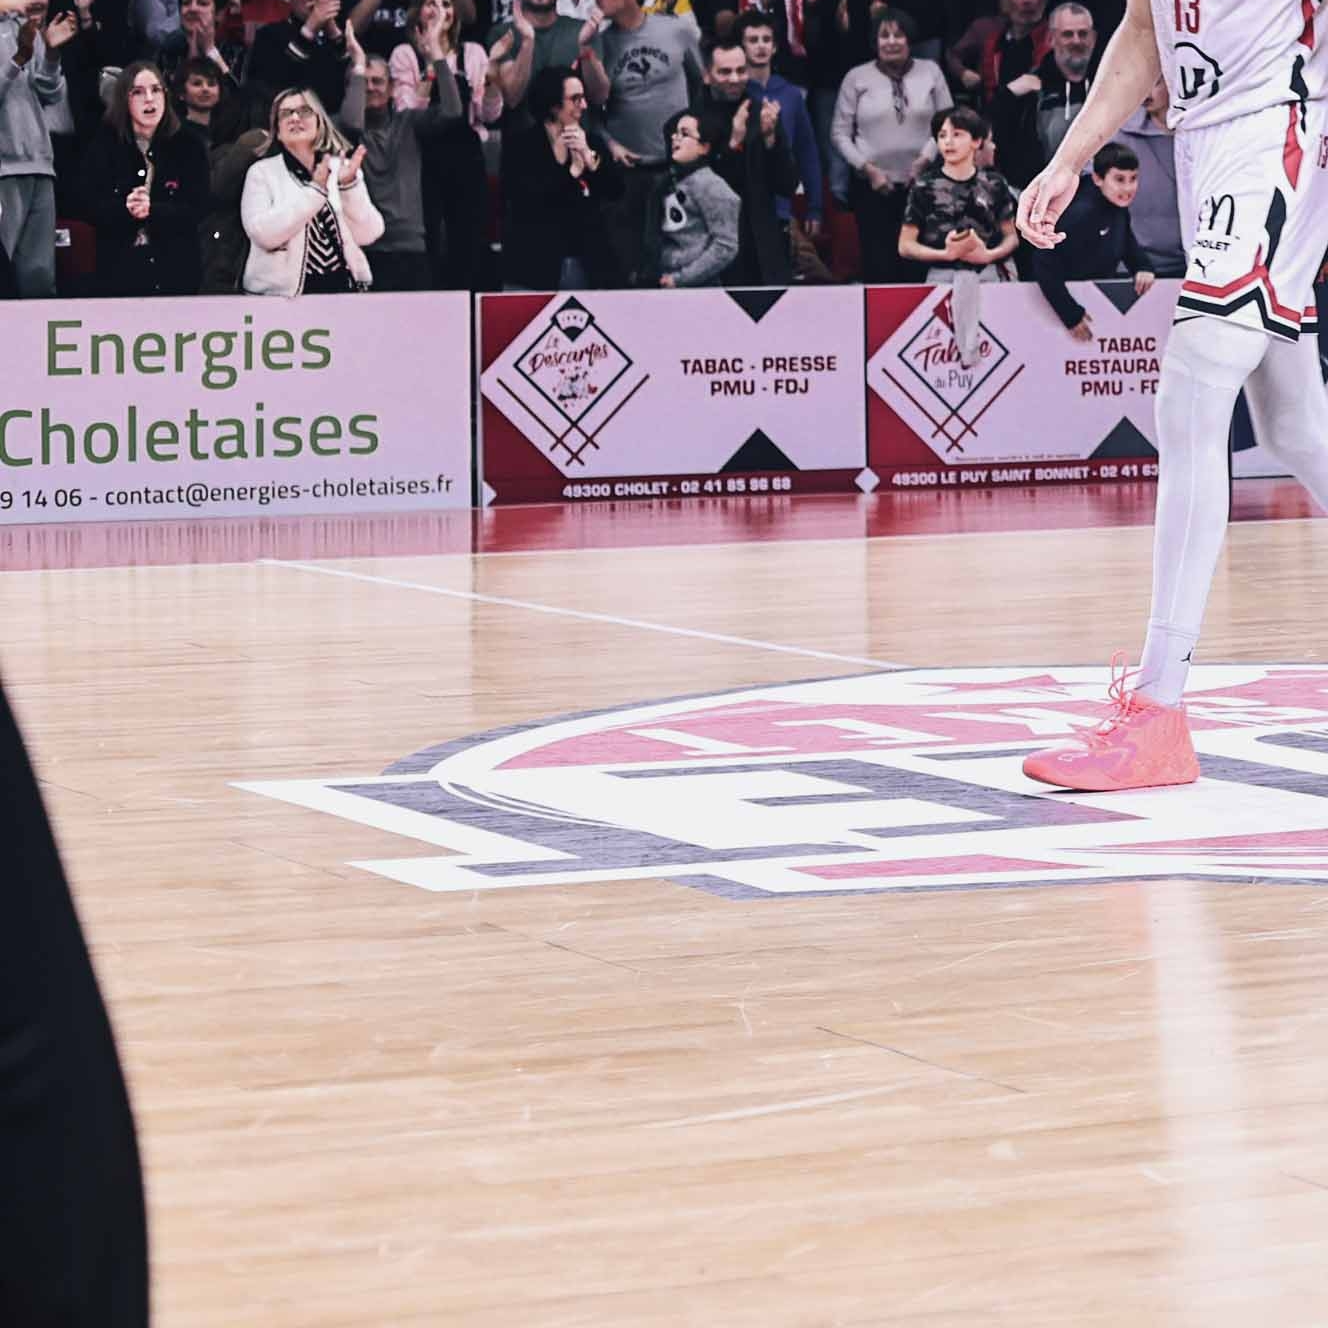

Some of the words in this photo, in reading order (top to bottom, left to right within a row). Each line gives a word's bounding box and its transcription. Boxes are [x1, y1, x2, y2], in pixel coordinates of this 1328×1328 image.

[47, 315, 332, 390] Energies
[913, 338, 992, 372] Tabe
[1099, 337, 1157, 353] TABAC
[680, 358, 744, 376] TABAC
[762, 356, 837, 373] PRESSE
[1065, 359, 1160, 376] RESTAURA
[710, 379, 755, 396] PMU
[774, 378, 809, 395] FDJ
[949, 369, 973, 390] Puy
[1081, 380, 1123, 397] PMU
[0, 402, 379, 467] Choletaises
[892, 473, 937, 486] 49300
[940, 472, 957, 485] LE
[960, 471, 988, 484] PUY
[991, 469, 1031, 483] SAINT
[1035, 468, 1089, 481] BONNET
[1100, 466, 1117, 479] 02
[1120, 464, 1138, 478] 41
[0, 491, 13, 510] 9
[22, 490, 48, 509] 14
[54, 488, 82, 508] 06
[105, 474, 453, 508] contact@energies-choletaises.fr
[563, 481, 610, 498] 49300
[614, 480, 668, 497] CHOLET
[681, 480, 700, 494] 02
[704, 479, 722, 493] 41
